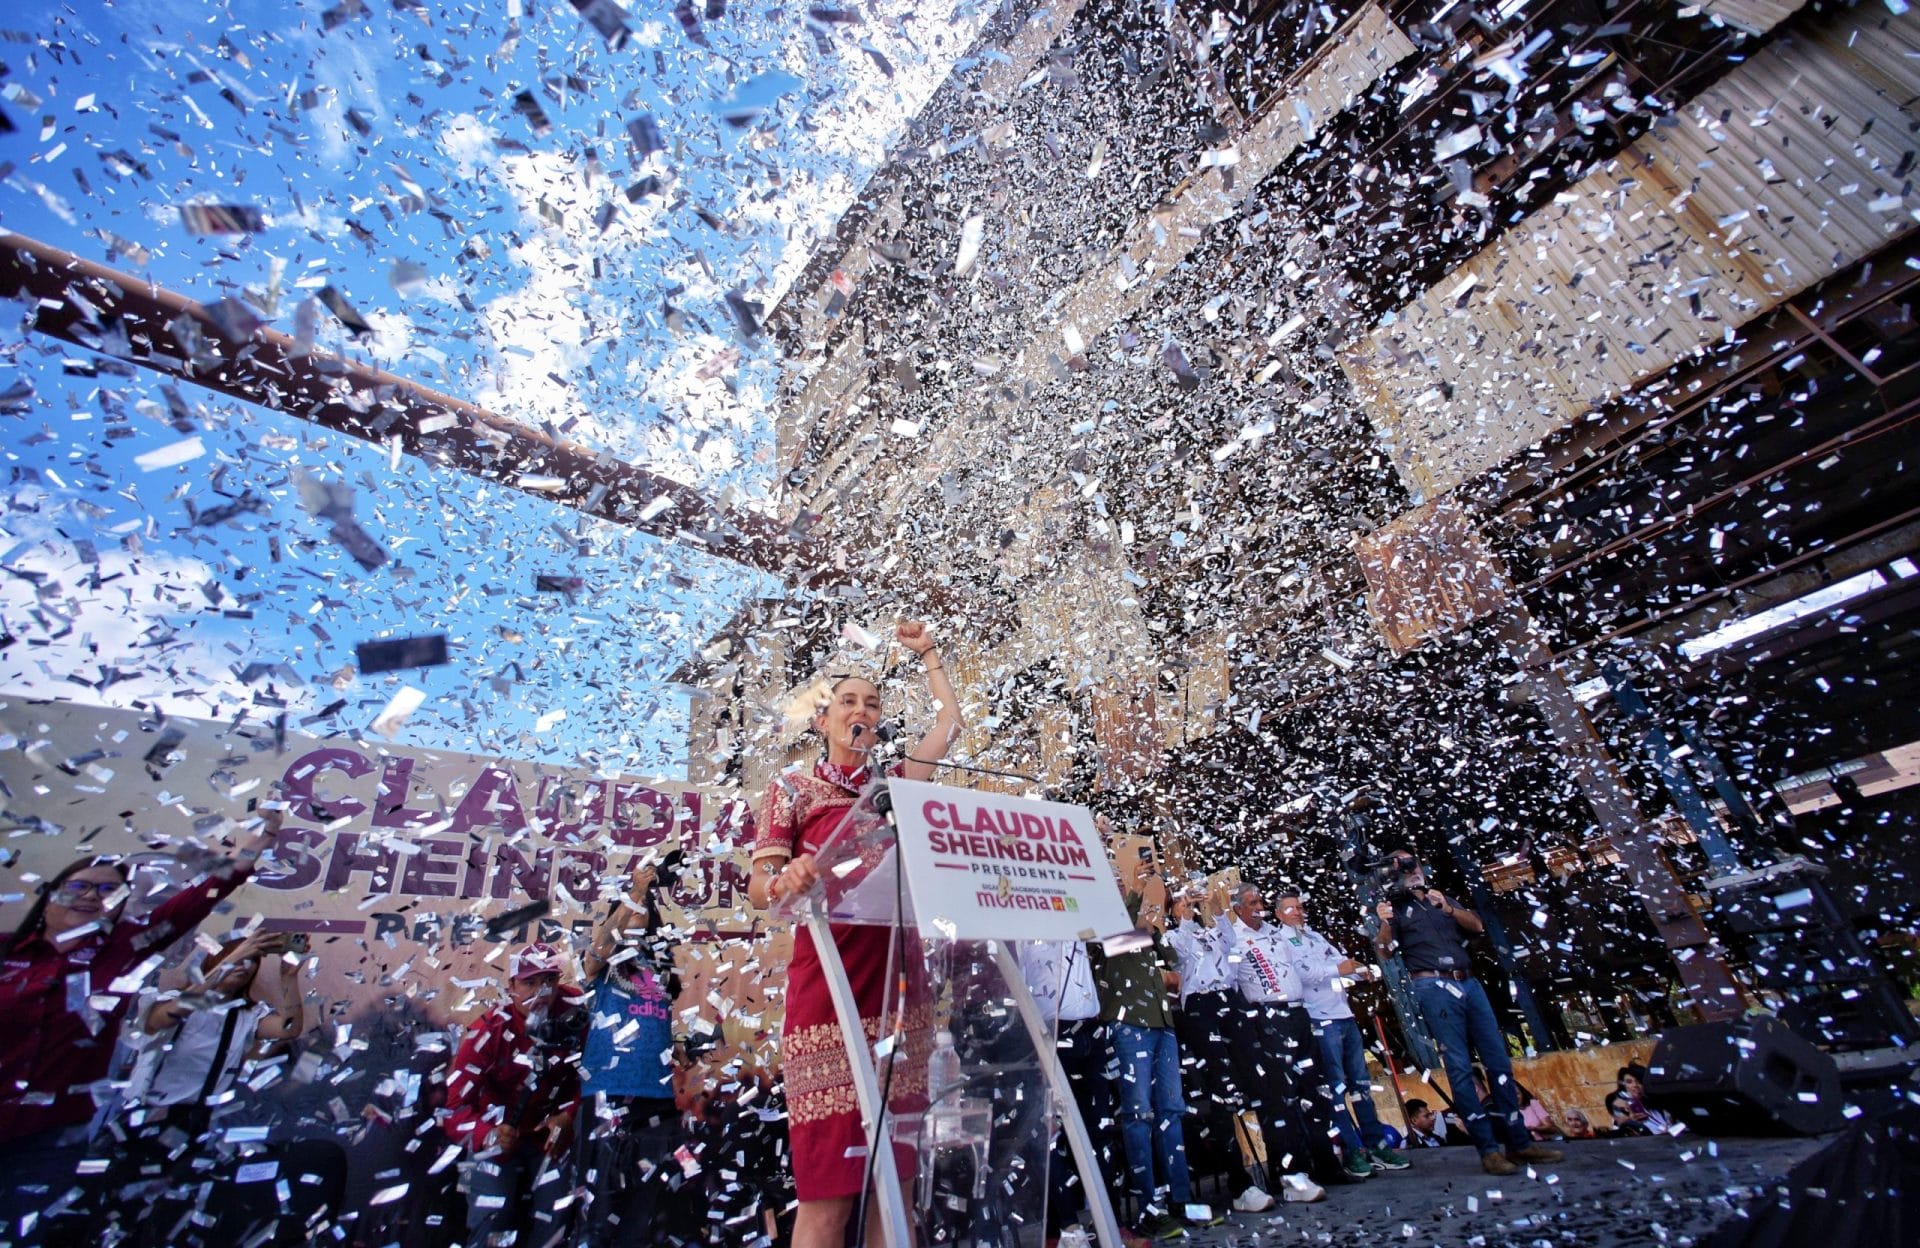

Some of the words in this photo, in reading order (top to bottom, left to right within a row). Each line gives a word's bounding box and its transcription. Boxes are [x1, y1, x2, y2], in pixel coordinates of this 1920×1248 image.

[281, 748, 757, 850] CLAUDIA
[922, 800, 1083, 845] CLAUDIA
[928, 831, 1092, 868] SHEINBAUM
[971, 862, 1067, 881] PRESIDENTA
[976, 891, 1051, 910] morena
